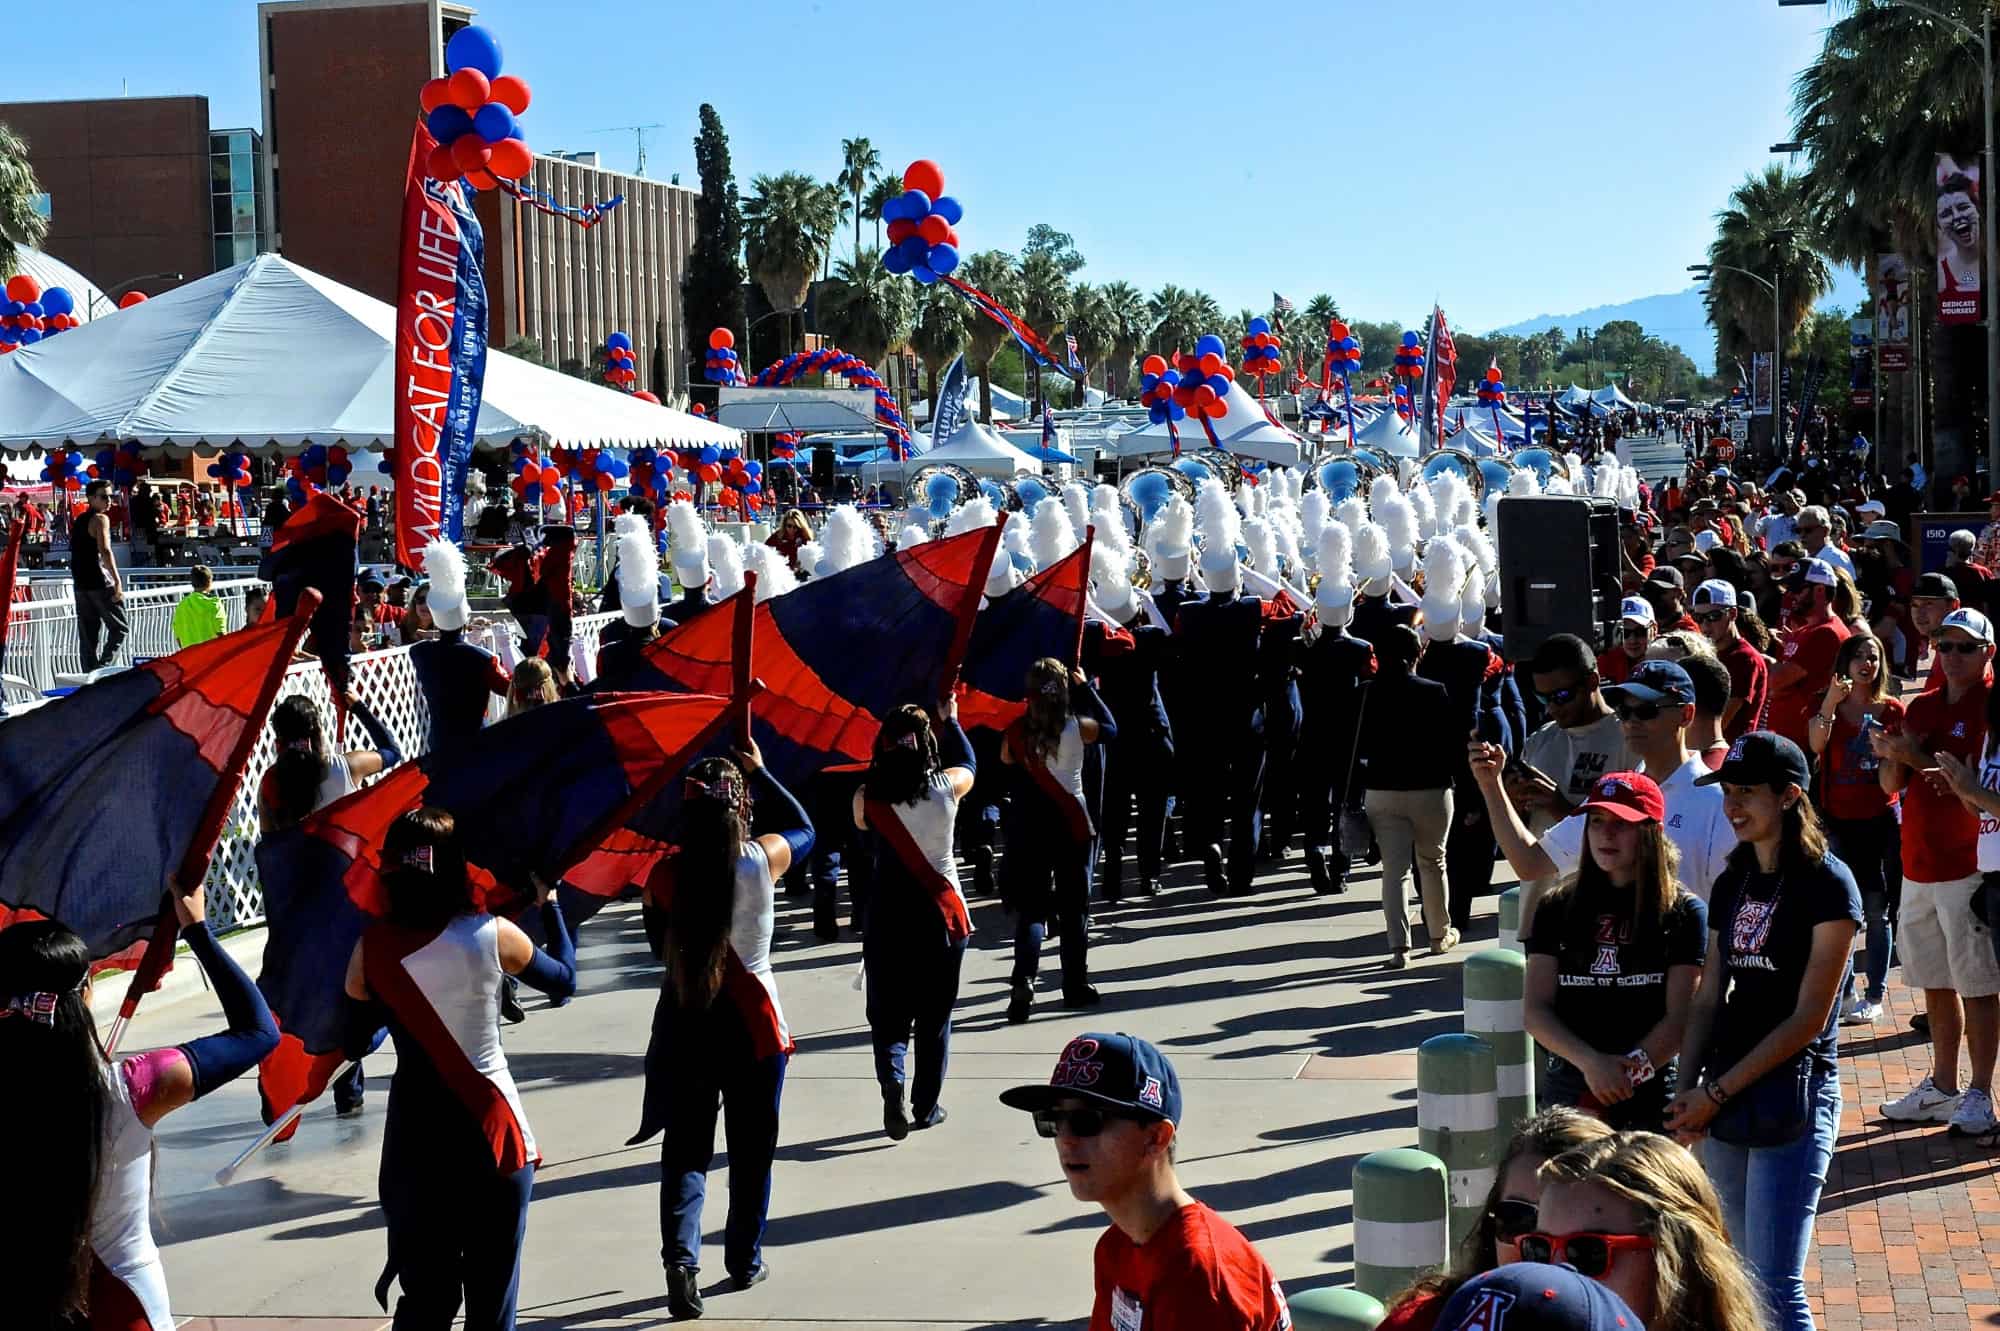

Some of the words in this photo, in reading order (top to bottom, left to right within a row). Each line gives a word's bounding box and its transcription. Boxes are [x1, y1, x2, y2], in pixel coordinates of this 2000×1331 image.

[418, 209, 461, 284] LIFE
[1941, 300, 1977, 308] DEDICATE
[1941, 307, 1977, 315] YOURSELF
[413, 289, 456, 374] FOR
[460, 362, 472, 425] ARIZONA
[455, 431, 466, 446] OF
[409, 375, 449, 554] WILDCAT
[1727, 738, 1747, 761] A
[1668, 814, 1681, 829] A
[1589, 944, 1622, 975] A
[1558, 974, 1596, 987] LLEGE
[1597, 977, 1614, 987] OF
[1139, 1075, 1163, 1109] A
[1455, 1287, 1517, 1331] A
